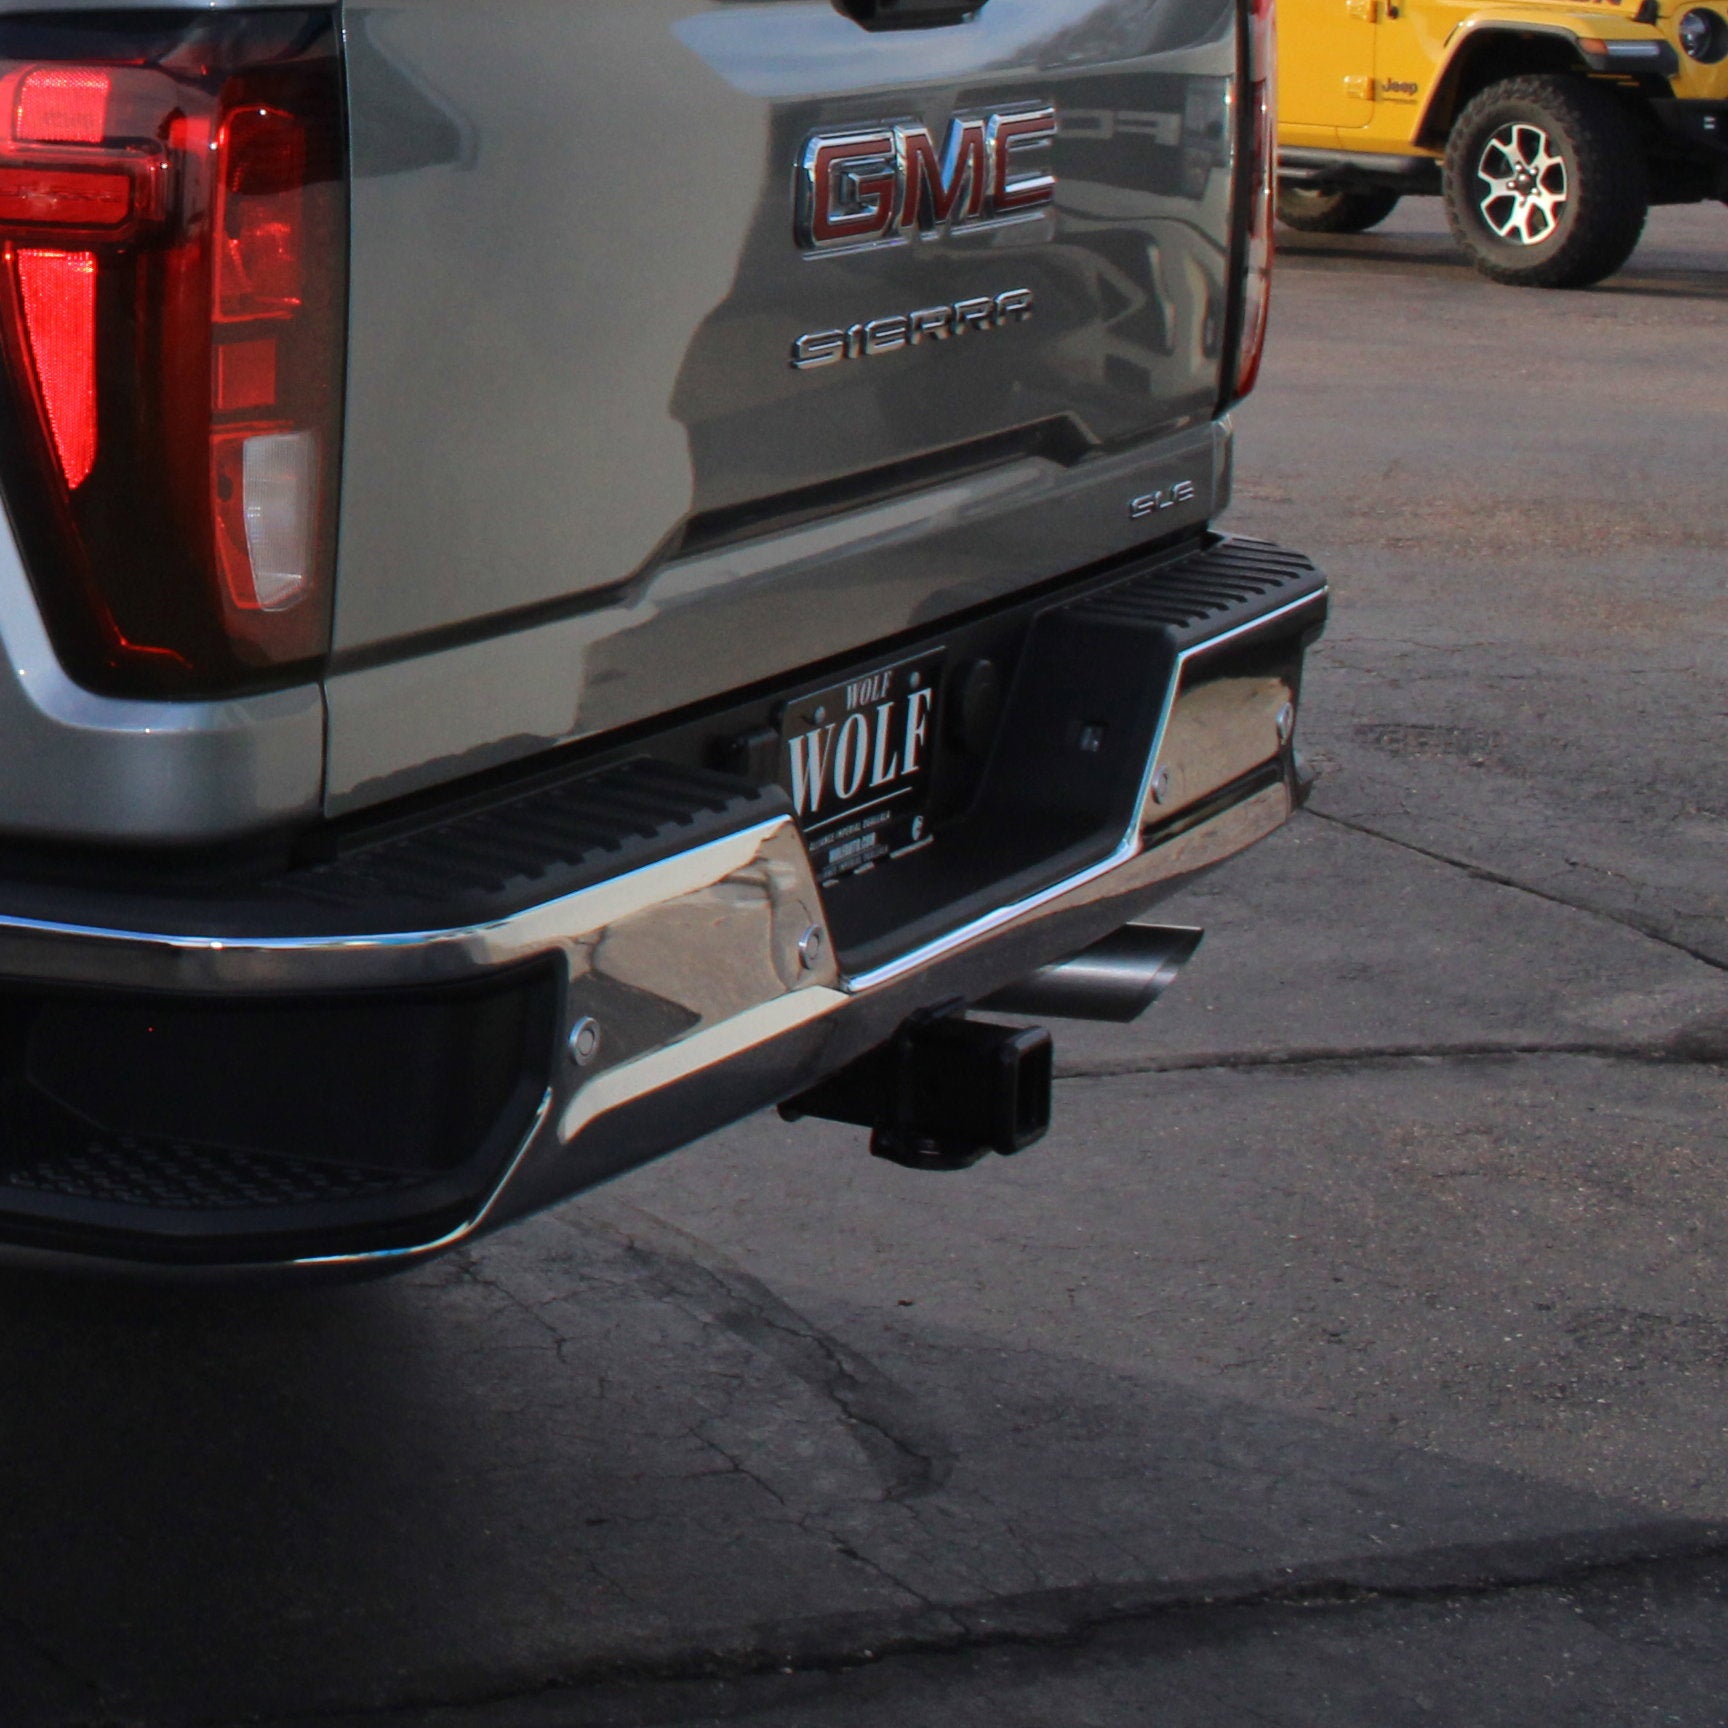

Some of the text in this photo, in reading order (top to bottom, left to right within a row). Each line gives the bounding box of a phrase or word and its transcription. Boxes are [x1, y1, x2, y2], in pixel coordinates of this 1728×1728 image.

[1381, 77, 1418, 96] Jeep
[794, 104, 1058, 252] GMC
[791, 287, 1035, 370] SIERRA
[1128, 479, 1196, 519] SLE
[846, 672, 892, 710] WOLF
[788, 688, 933, 817] WOLF
